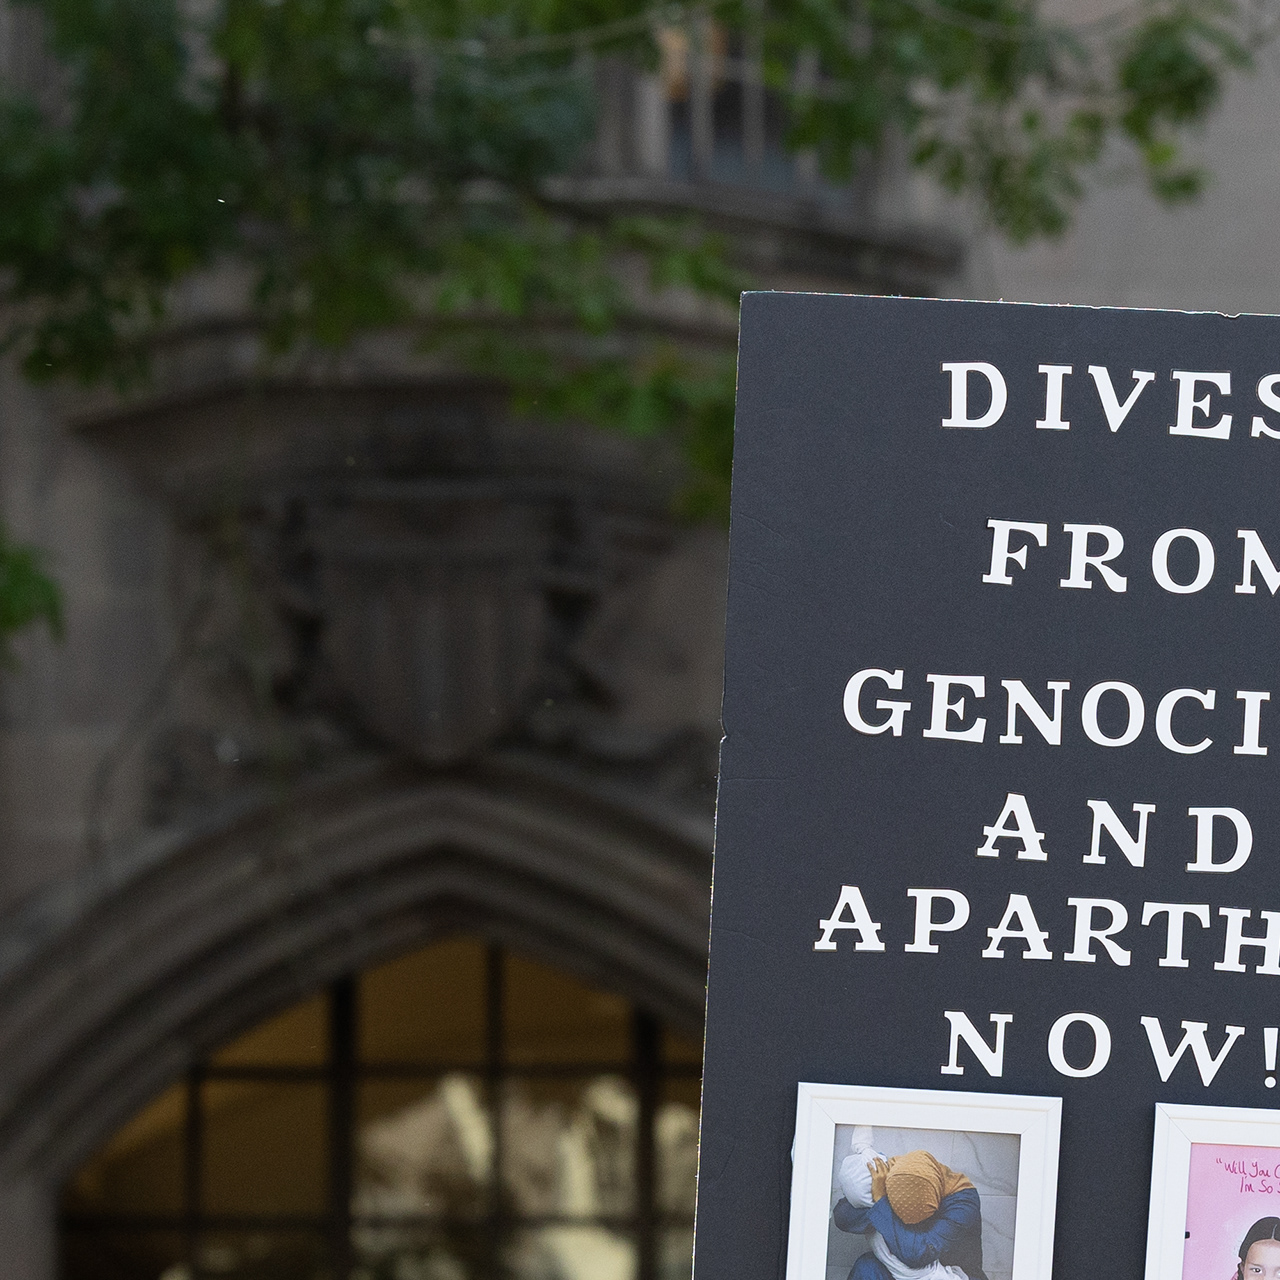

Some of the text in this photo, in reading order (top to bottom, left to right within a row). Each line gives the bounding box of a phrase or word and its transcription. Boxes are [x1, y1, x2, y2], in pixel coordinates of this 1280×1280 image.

[976, 792, 1253, 873] AND
[940, 1010, 1280, 1088] NOW!
[1240, 1175, 1254, 1193] I'm
[1259, 1180, 1273, 1194] So
[1249, 1161, 1270, 1178] You
